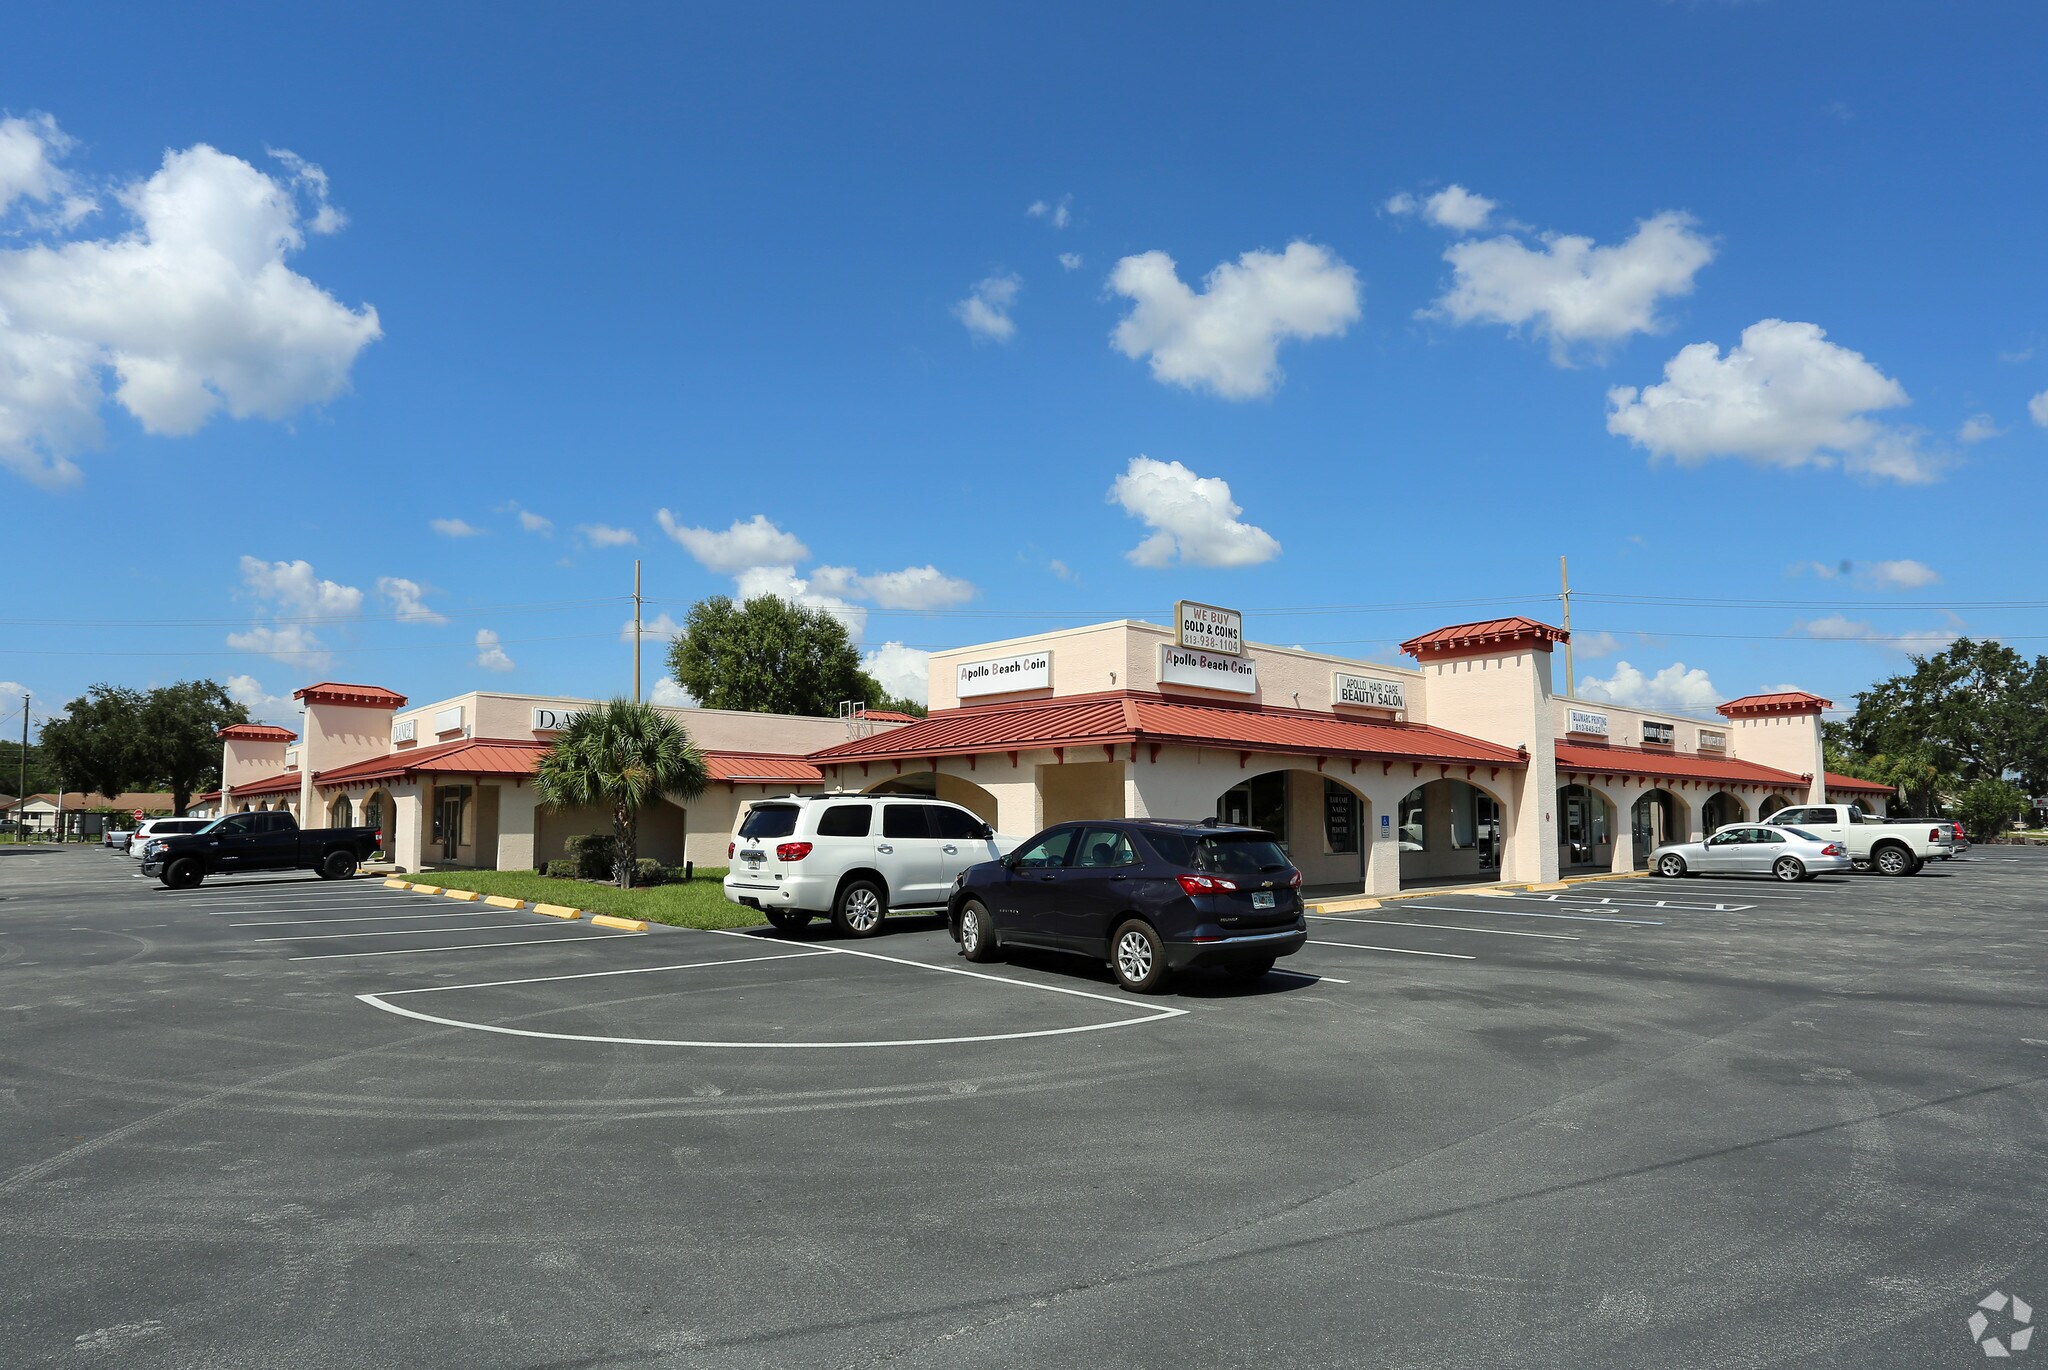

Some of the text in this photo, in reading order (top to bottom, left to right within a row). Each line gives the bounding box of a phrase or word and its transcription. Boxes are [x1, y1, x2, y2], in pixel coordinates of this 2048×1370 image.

[1194, 608, 1229, 625] WE BUY
[1184, 619, 1238, 639] GOLD & COINS
[1184, 634, 1238, 652] 813-938-1104
[961, 658, 1046, 681] Apollo Beach Coin
[1166, 650, 1252, 675] Apollo Beach Coin
[1346, 678, 1398, 694] APOLLO HAIR CARE
[1342, 688, 1403, 707] BEAUTY SALON
